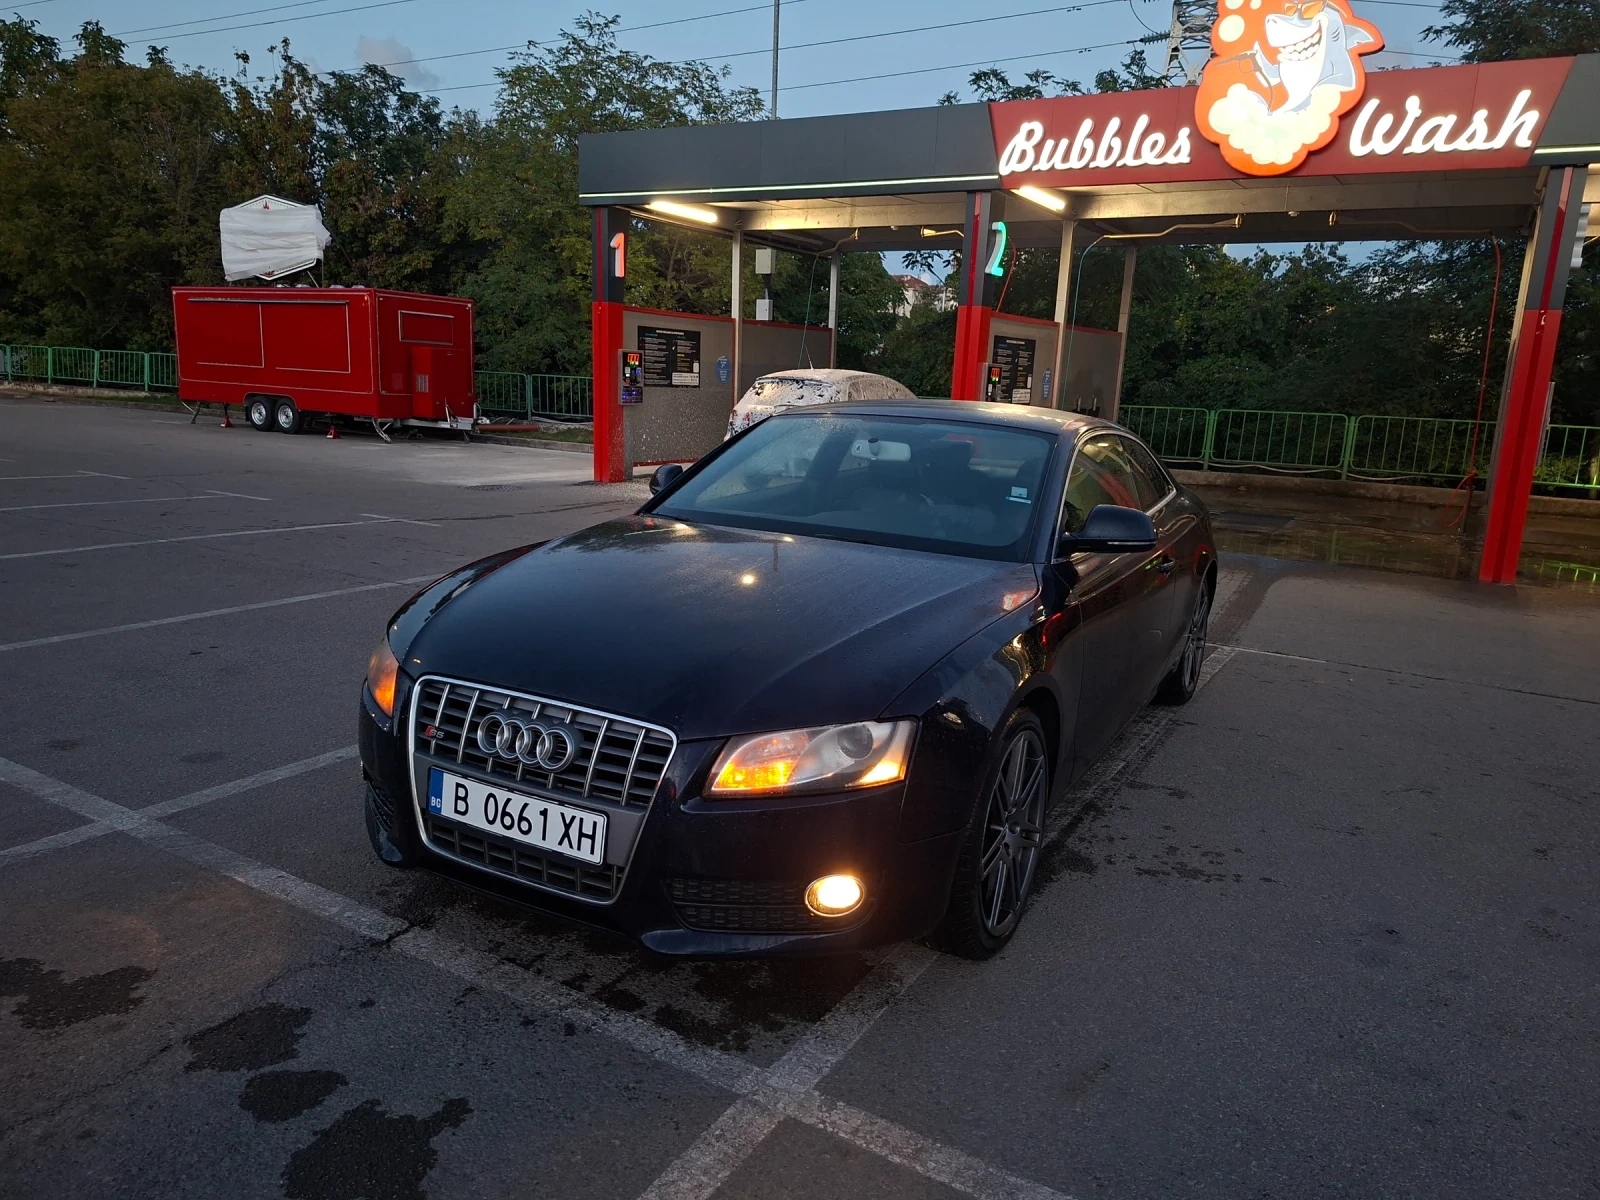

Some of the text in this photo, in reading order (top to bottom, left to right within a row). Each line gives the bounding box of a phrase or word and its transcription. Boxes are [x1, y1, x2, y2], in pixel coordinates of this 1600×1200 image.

[998, 89, 1540, 175] Bubbles Wash
[610, 232, 624, 277] 1
[985, 221, 1006, 277] 2
[431, 796, 441, 808] BG
[453, 781, 598, 856] B 0661 XH
